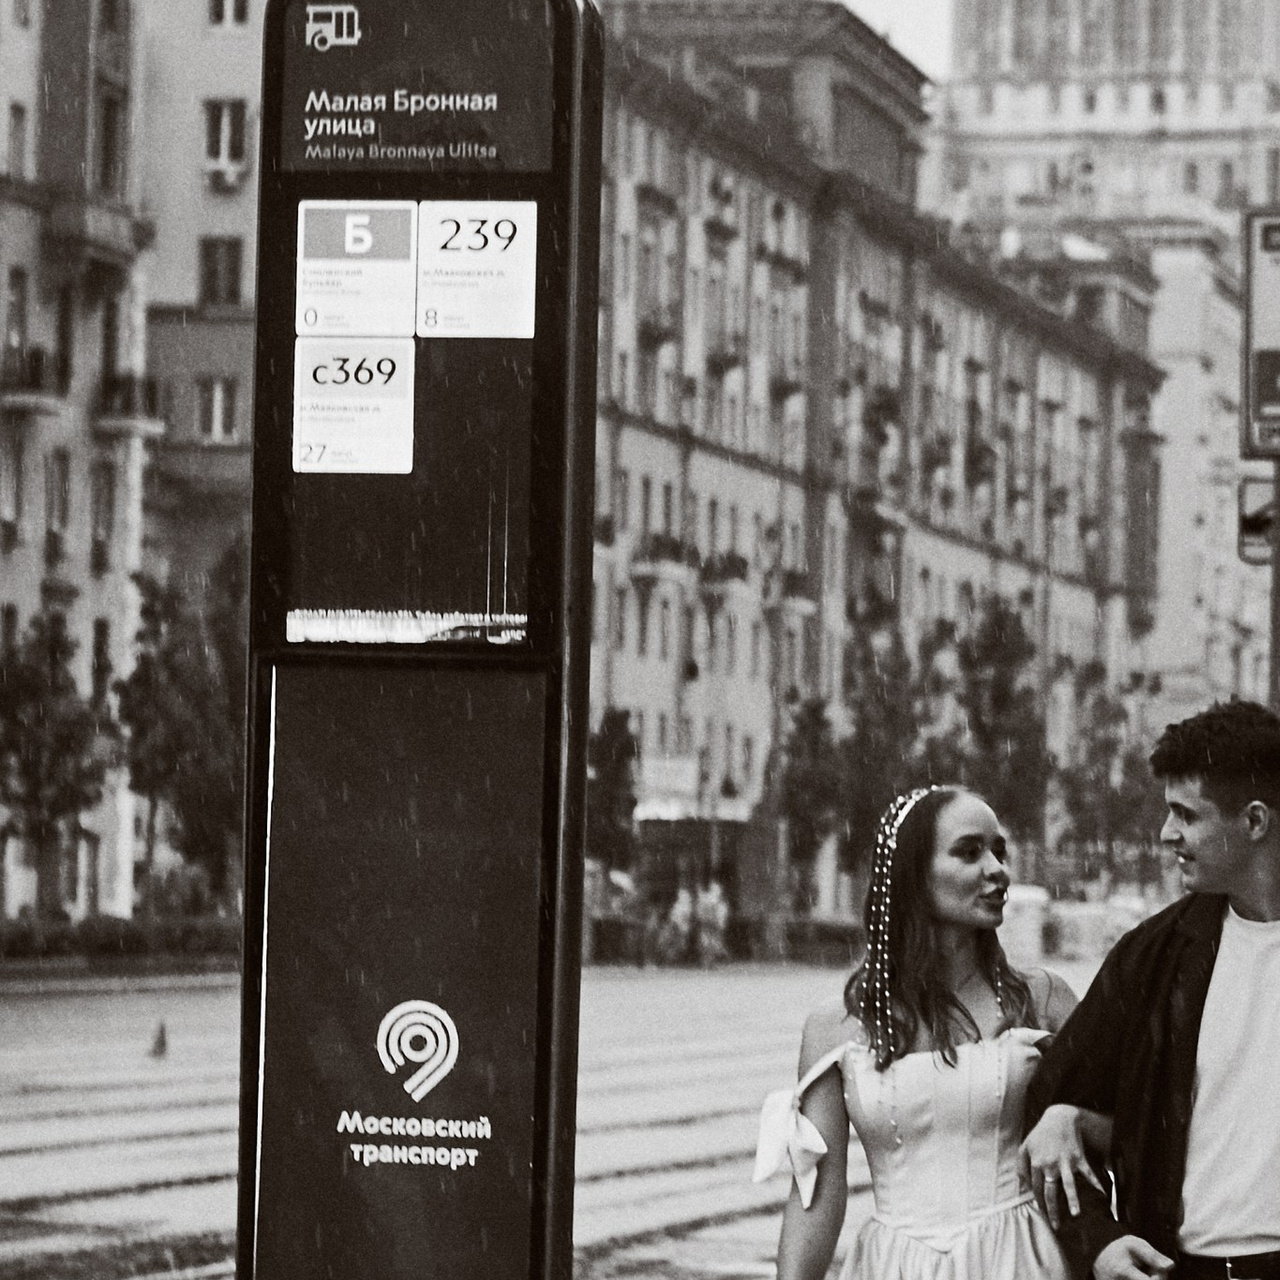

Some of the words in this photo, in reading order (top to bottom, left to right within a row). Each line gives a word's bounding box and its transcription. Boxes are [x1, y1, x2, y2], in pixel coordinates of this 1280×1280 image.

[304, 91, 387, 113] Малая
[393, 90, 498, 116] Бронная
[304, 117, 376, 140] улица
[305, 144, 365, 160] Malaya
[368, 144, 445, 160] Bronnaya
[449, 143, 497, 159] Ulitsa
[344, 215, 373, 254] Б
[439, 218, 519, 252] 239
[304, 308, 318, 327] 0
[424, 308, 438, 327] 8
[300, 443, 327, 463] 27
[337, 1110, 491, 1139] Московский
[350, 1143, 479, 1170] транспорт
